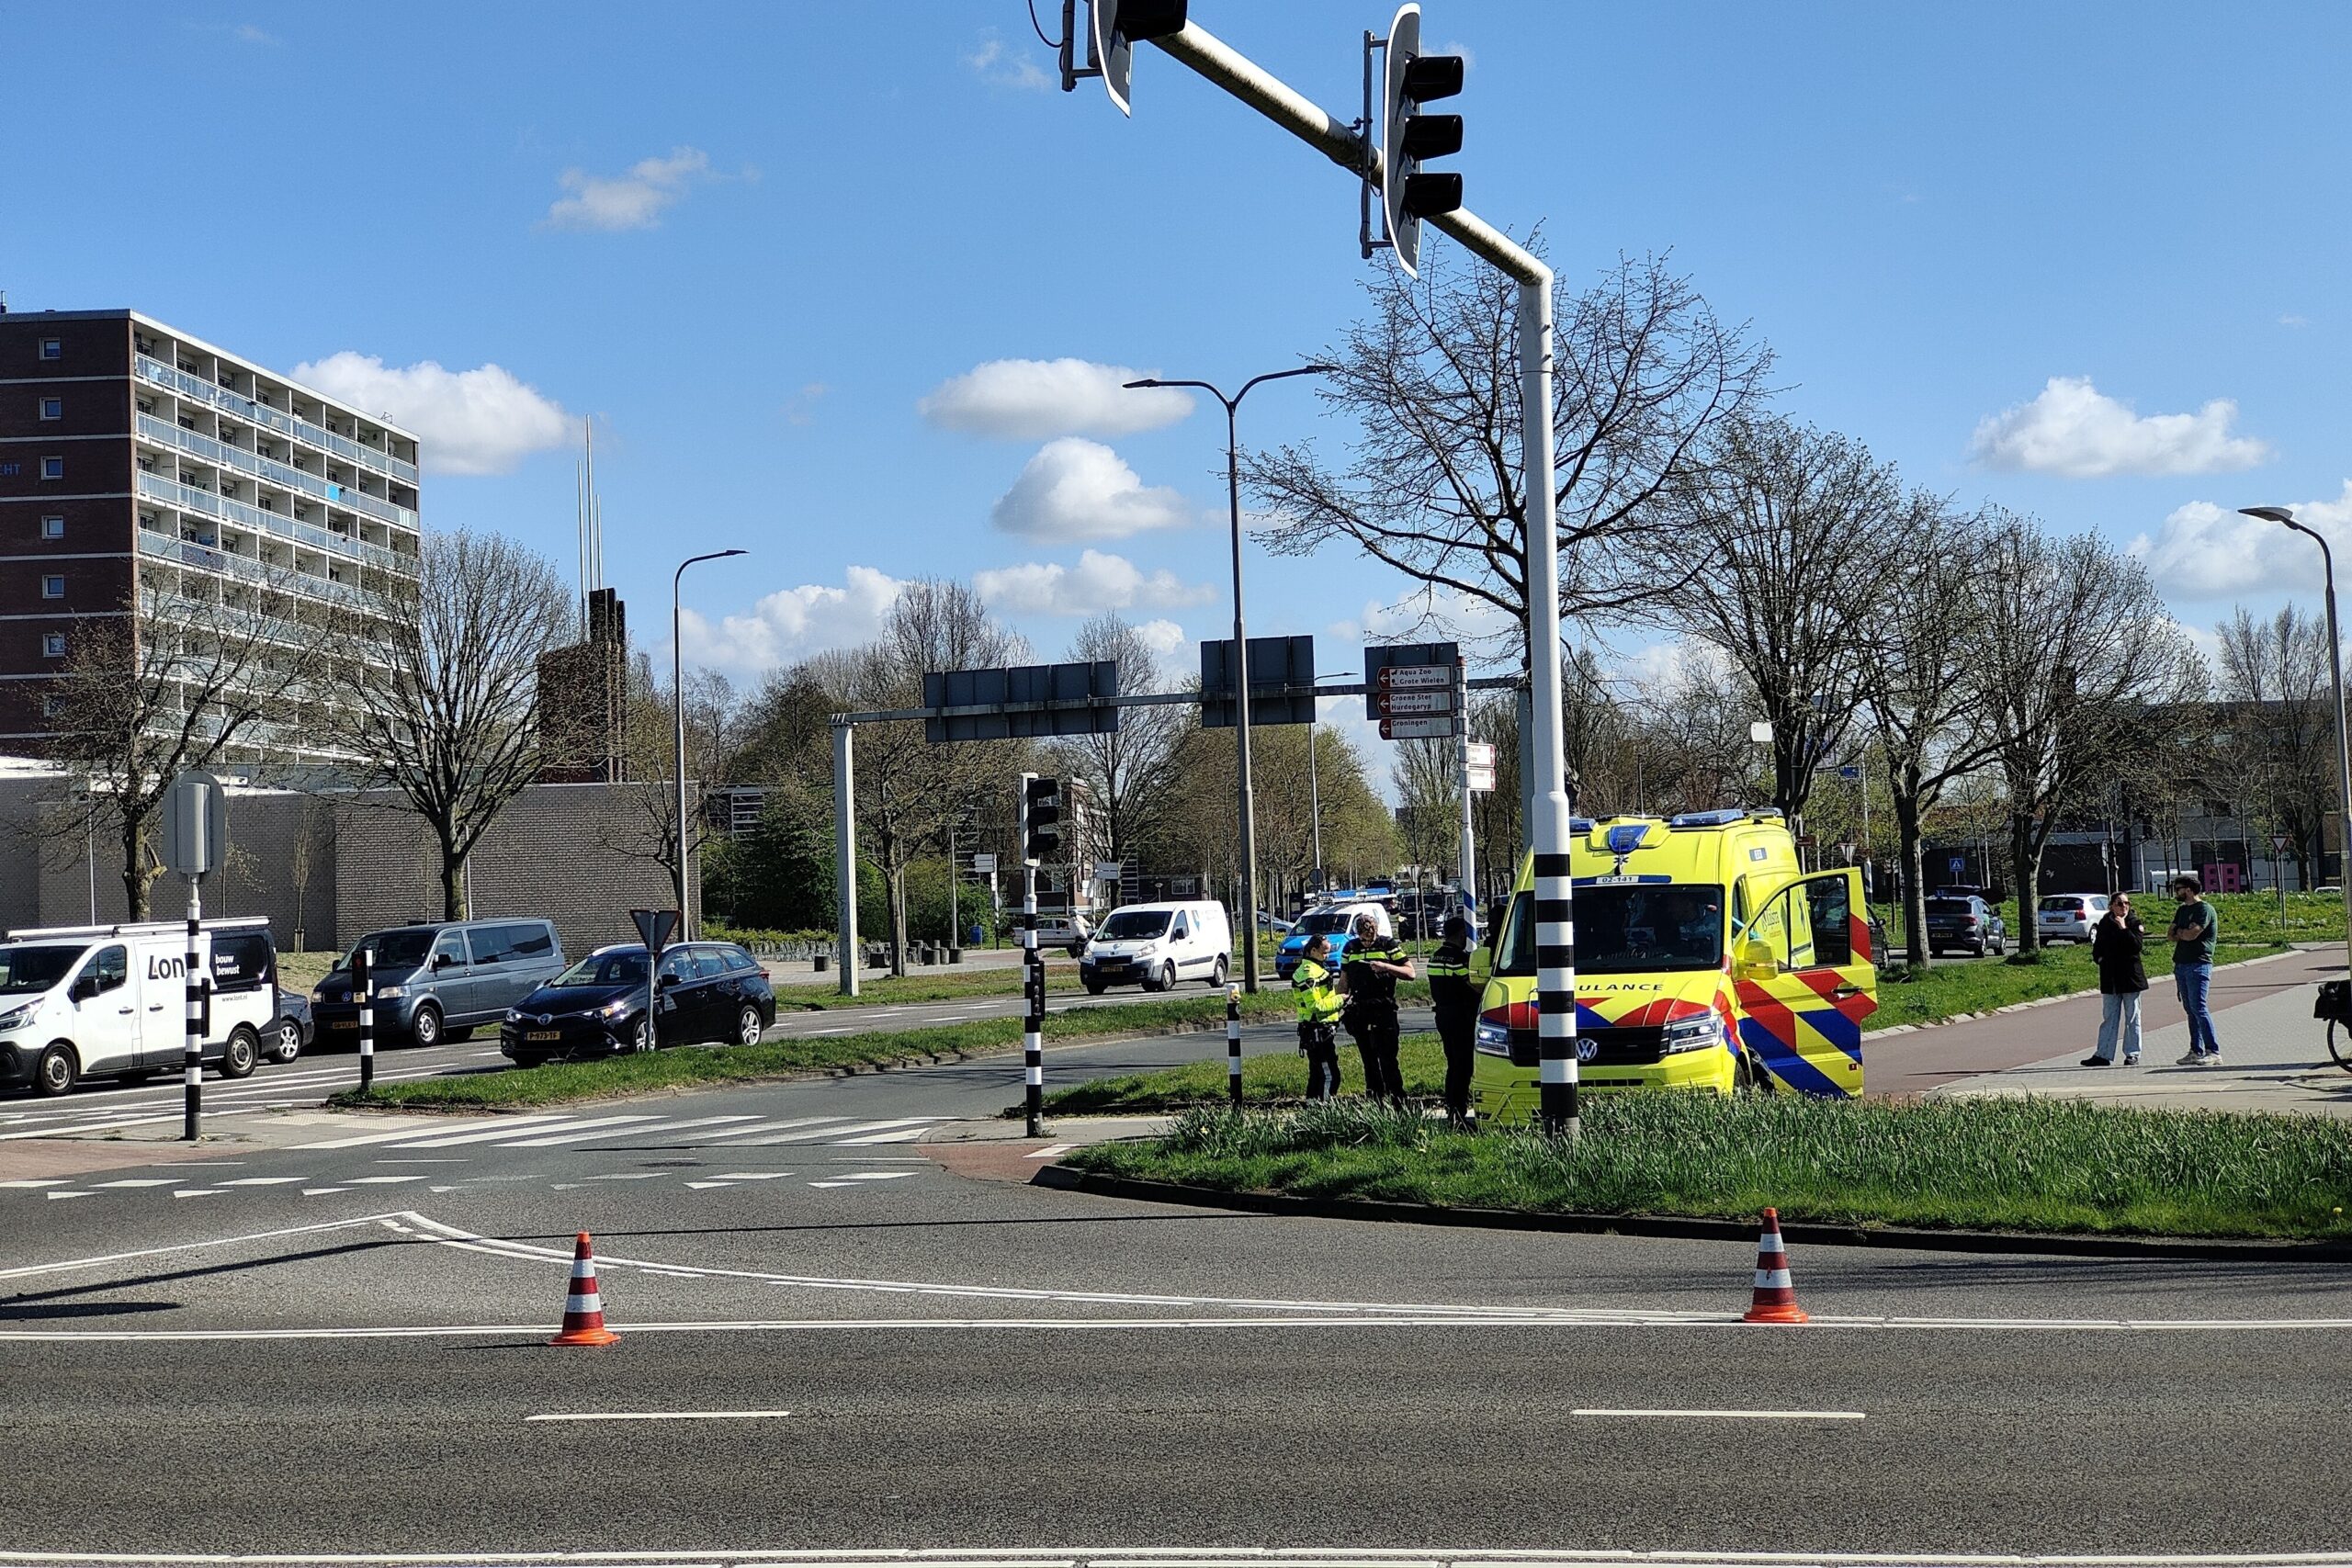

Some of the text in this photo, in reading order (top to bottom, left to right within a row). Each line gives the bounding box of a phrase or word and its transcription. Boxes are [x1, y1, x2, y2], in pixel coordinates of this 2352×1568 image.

[215, 954, 234, 964] bouw
[148, 954, 186, 980] Lon
[216, 964, 241, 976] bewust
[1530, 983, 1664, 993] AULANCE
